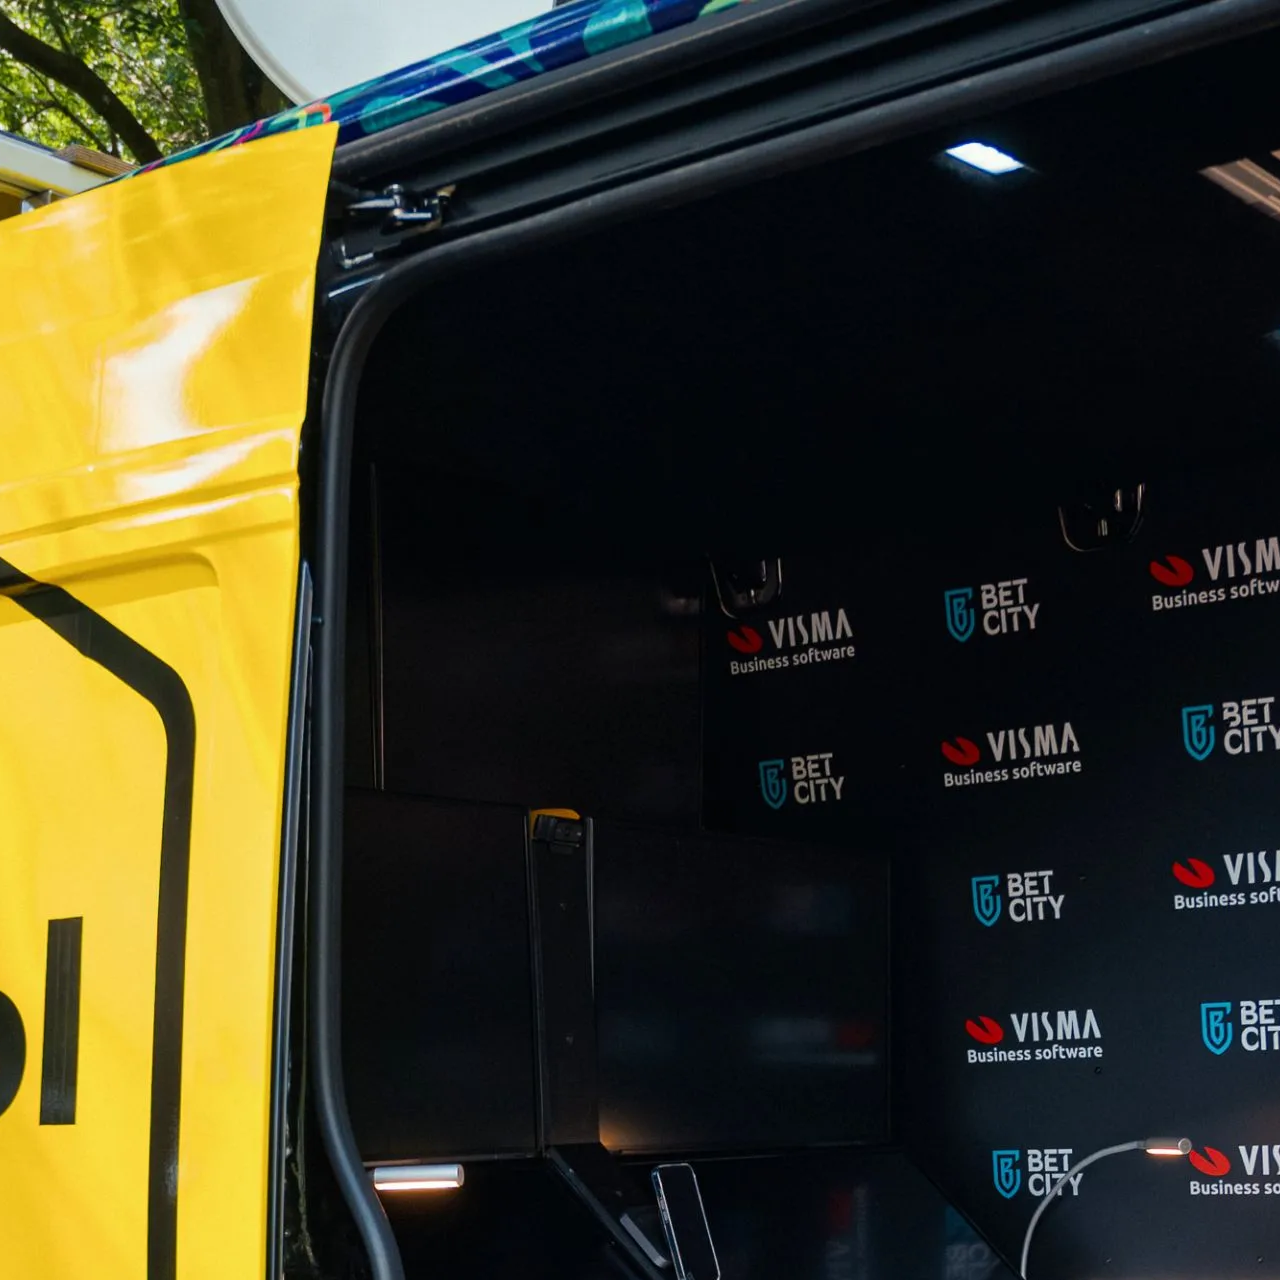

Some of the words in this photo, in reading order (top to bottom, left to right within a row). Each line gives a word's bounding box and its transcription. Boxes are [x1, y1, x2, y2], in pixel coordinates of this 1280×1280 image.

[981, 578, 1028, 610] BET
[1152, 588, 1226, 611] Business
[767, 608, 854, 649] VISMA
[983, 603, 1039, 635] CITY
[730, 656, 789, 675] Business
[792, 646, 855, 665] software
[1222, 697, 1275, 727] BET
[986, 722, 1080, 762] VISMA
[791, 752, 833, 780] BET
[944, 769, 1009, 787] Business
[1012, 760, 1081, 779] software
[794, 776, 844, 804] CITY
[1007, 870, 1053, 897] BET
[1009, 895, 1065, 922] CITY
[1174, 892, 1246, 909] Business
[1010, 1009, 1101, 1042] VISMA
[967, 1047, 1031, 1063] Business
[1035, 1044, 1103, 1060] software
[1027, 1148, 1073, 1172] BET
[1028, 1173, 1083, 1197] CITY
[1190, 1179, 1260, 1195] Business
